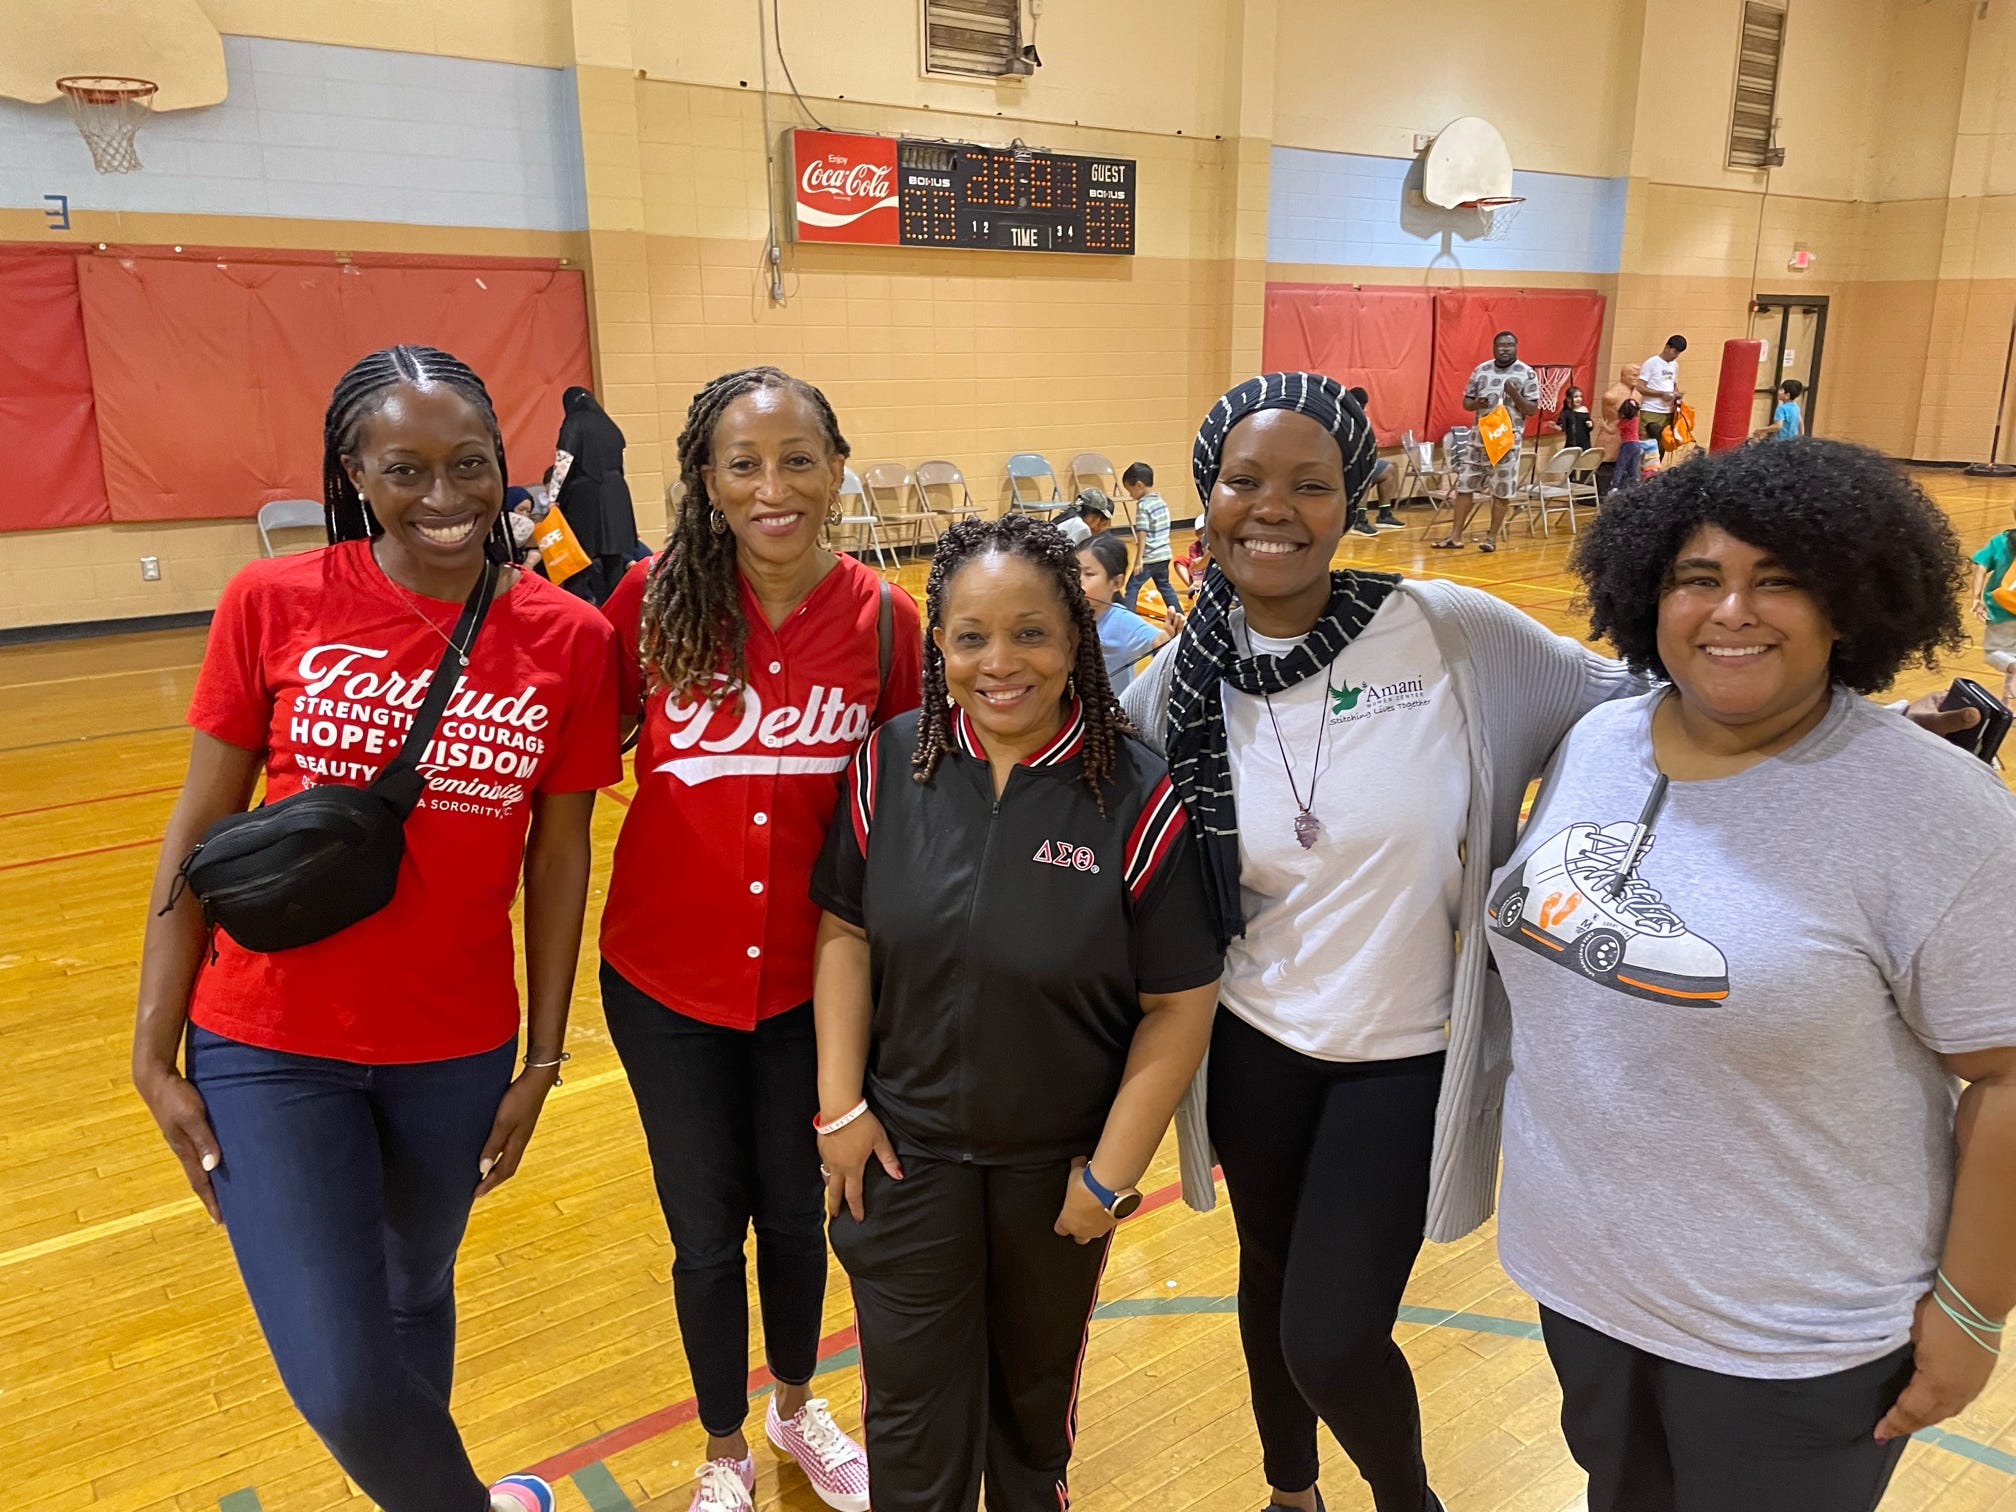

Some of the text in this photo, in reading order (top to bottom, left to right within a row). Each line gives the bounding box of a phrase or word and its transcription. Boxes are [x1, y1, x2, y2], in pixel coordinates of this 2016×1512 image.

[908, 175, 951, 188] BONUS
[1091, 164, 1126, 184] GUEST
[1089, 189, 1126, 200] BONUS
[1010, 228, 1039, 248] TIME
[297, 643, 550, 732] Forttude
[1366, 674, 1423, 703] Amani
[665, 672, 869, 753] Delta
[1329, 699, 1432, 726] Stitching Lives Together
[290, 717, 386, 754] HOPE
[442, 721, 545, 754] COURAGE
[294, 753, 379, 782] BEAUTY
